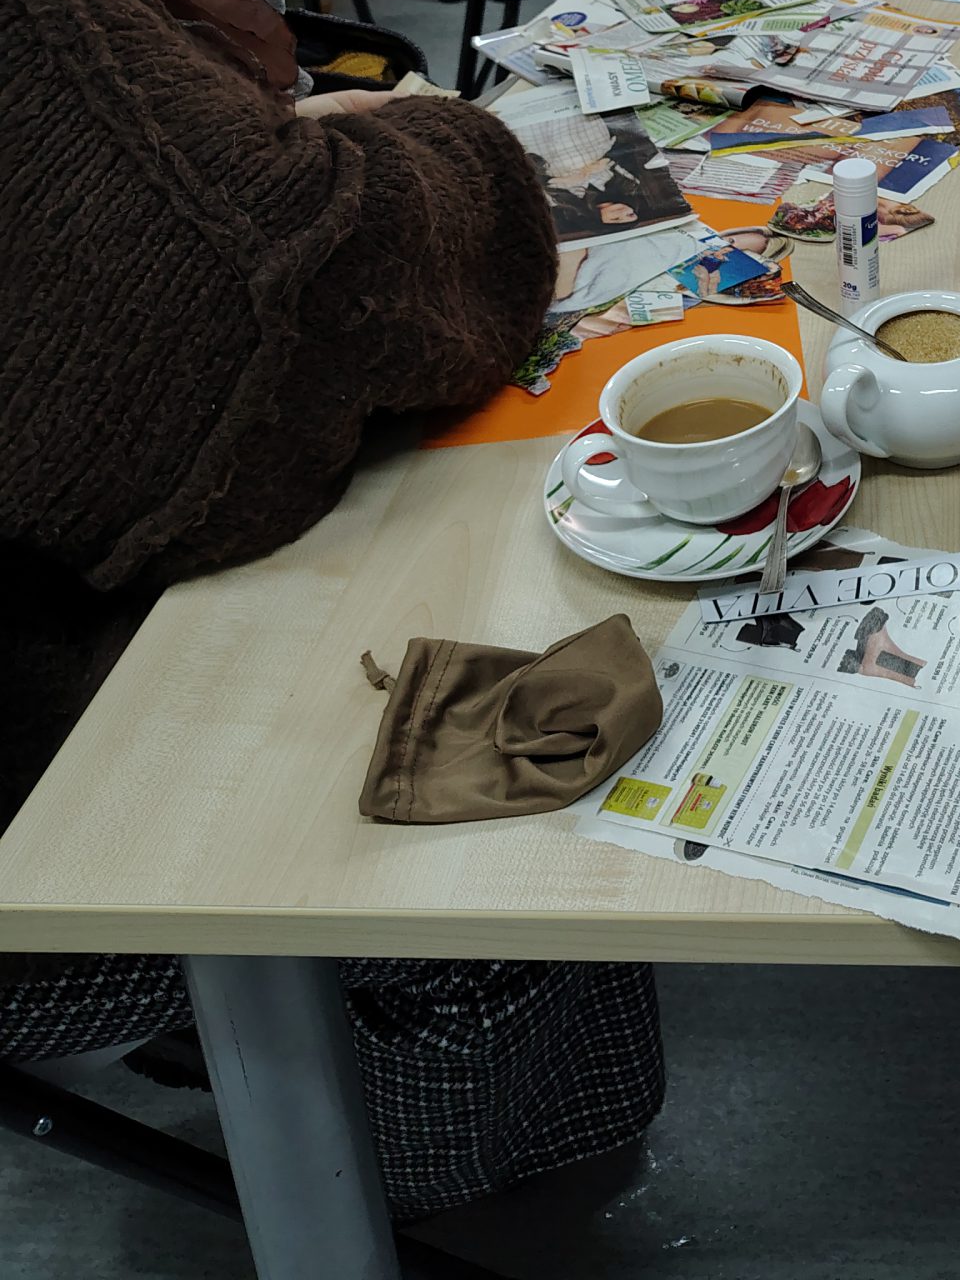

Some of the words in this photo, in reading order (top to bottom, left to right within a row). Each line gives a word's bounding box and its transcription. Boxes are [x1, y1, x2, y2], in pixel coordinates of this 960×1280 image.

[607, 71, 622, 97] KWASY
[843, 282, 857, 291] 20g
[710, 581, 820, 620] VITA
[938, 635, 955, 661] Deichmann,
[873, 763, 893, 787] Wyniki
[864, 786, 883, 808] badań
